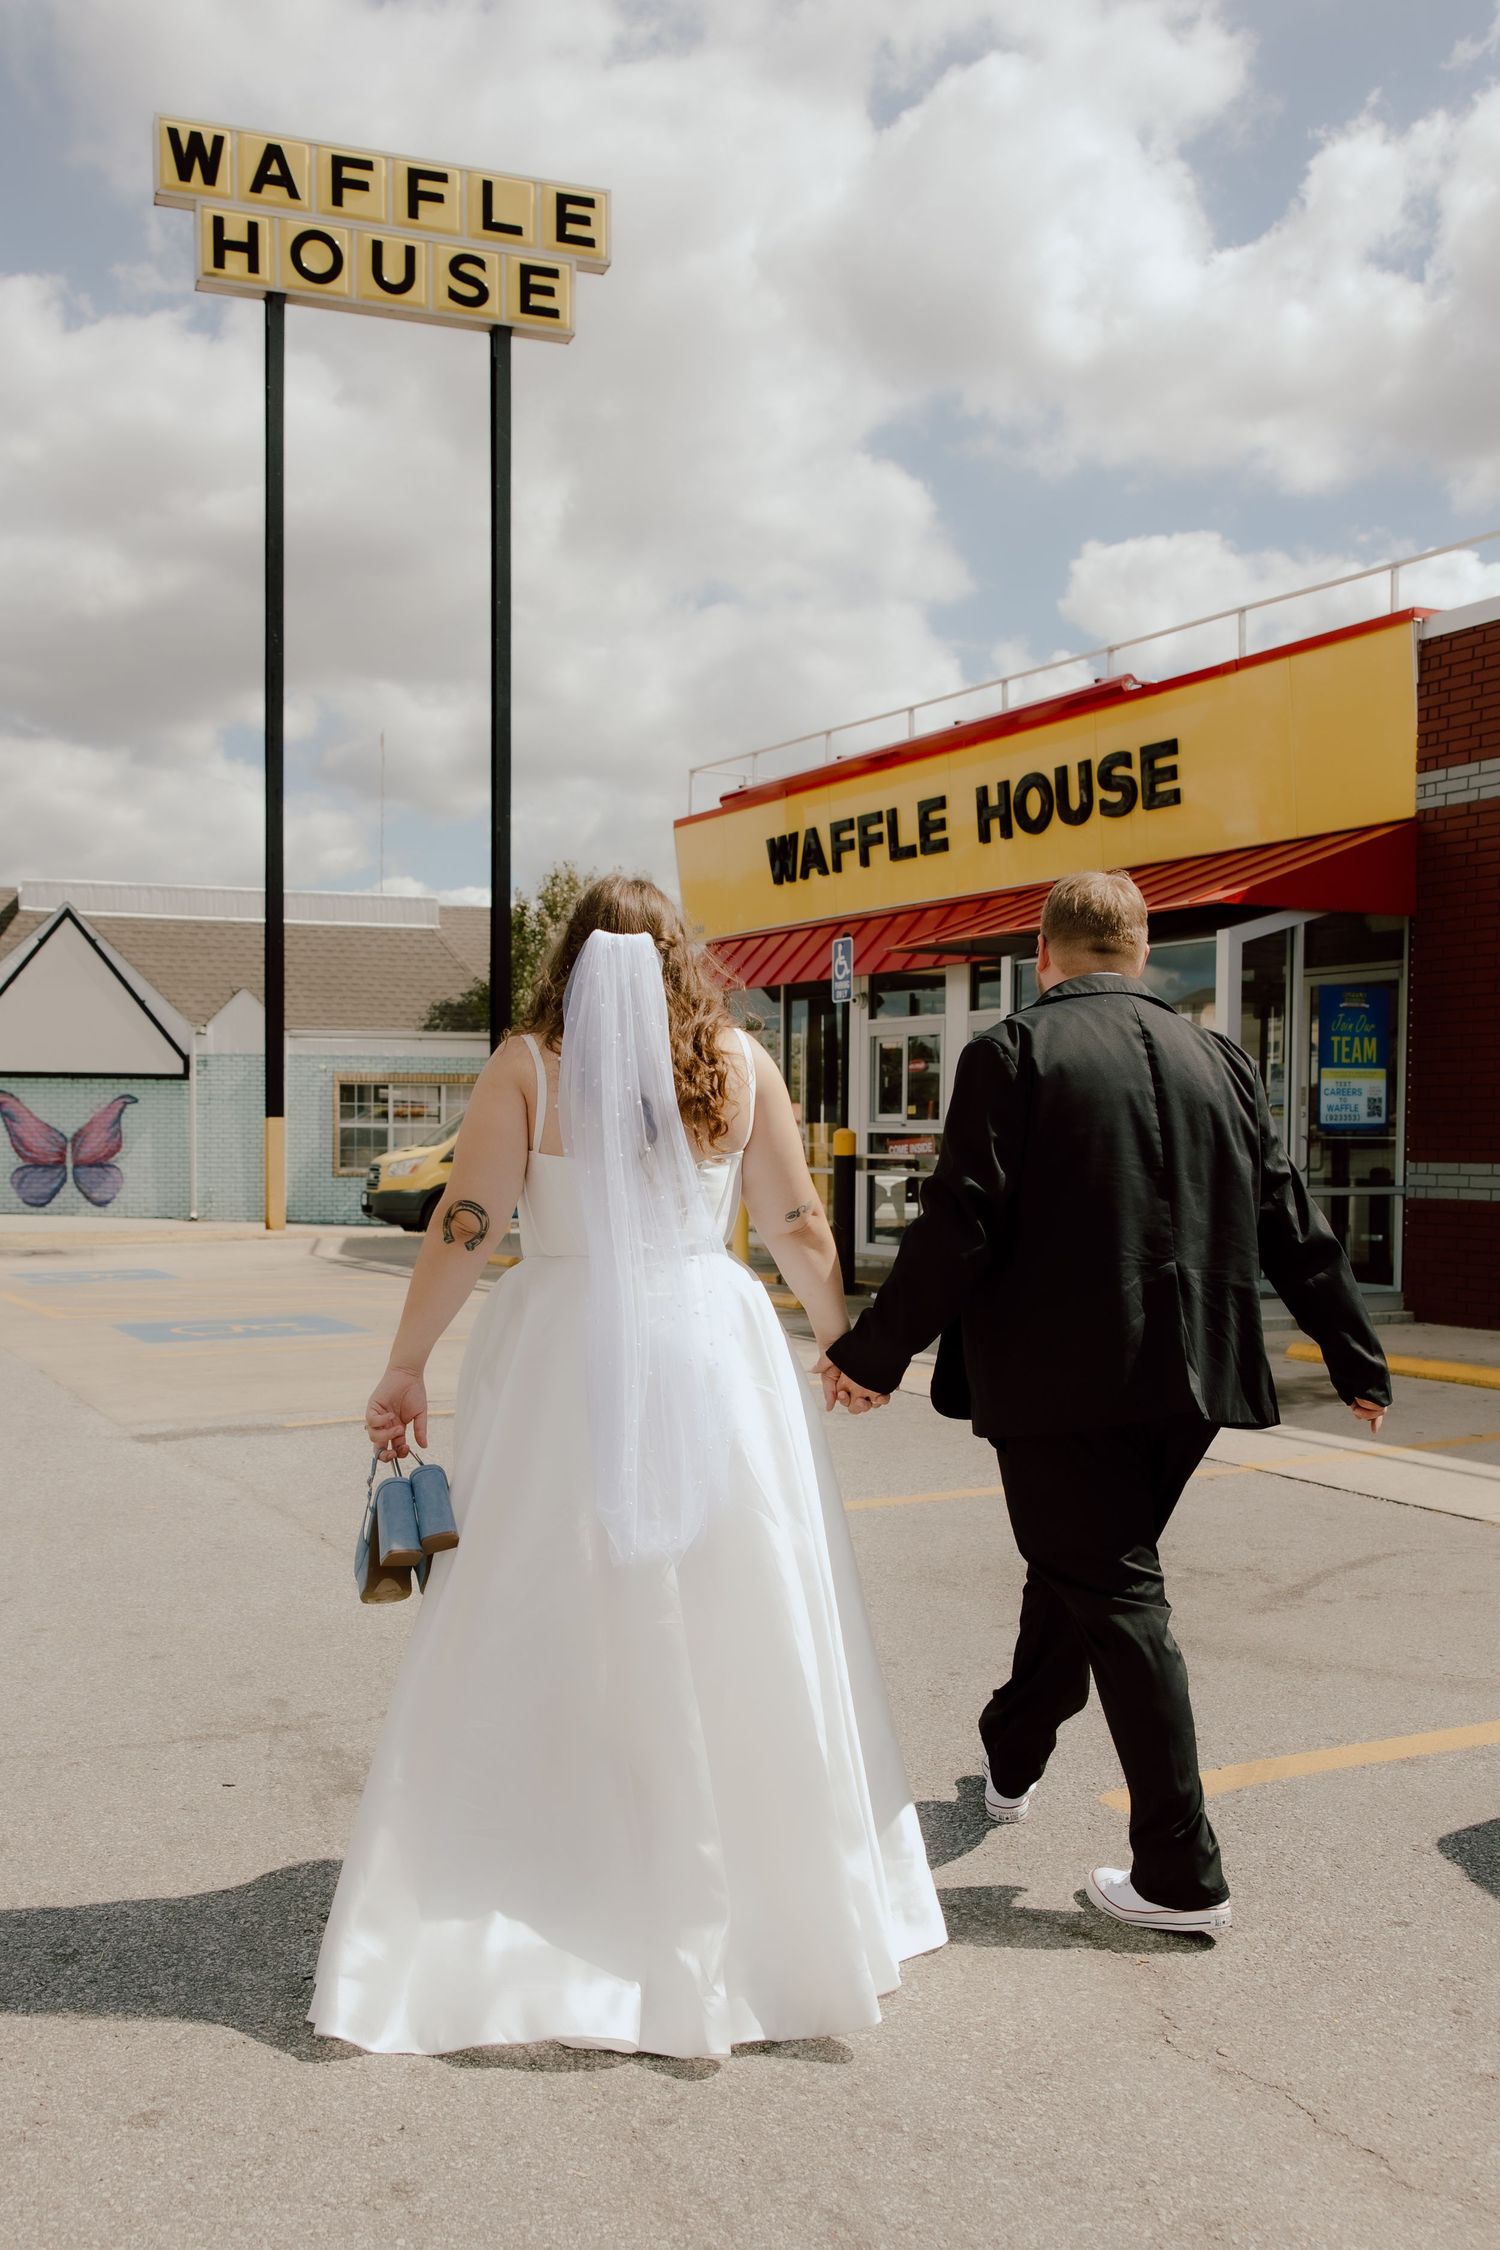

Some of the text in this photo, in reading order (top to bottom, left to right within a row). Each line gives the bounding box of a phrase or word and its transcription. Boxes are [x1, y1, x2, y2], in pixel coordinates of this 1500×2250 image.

[166, 126, 596, 249] WAFFLE
[212, 215, 560, 319] HOUSE
[766, 737, 1183, 885] WAFFLE HOUSE
[1331, 1013, 1375, 1032] Join Our
[1330, 1035, 1377, 1064] TEAM
[1323, 1088, 1363, 1096] CAREERS
[1327, 1103, 1359, 1112] WAFFLE
[888, 1142, 933, 1155] COME INSIDE
